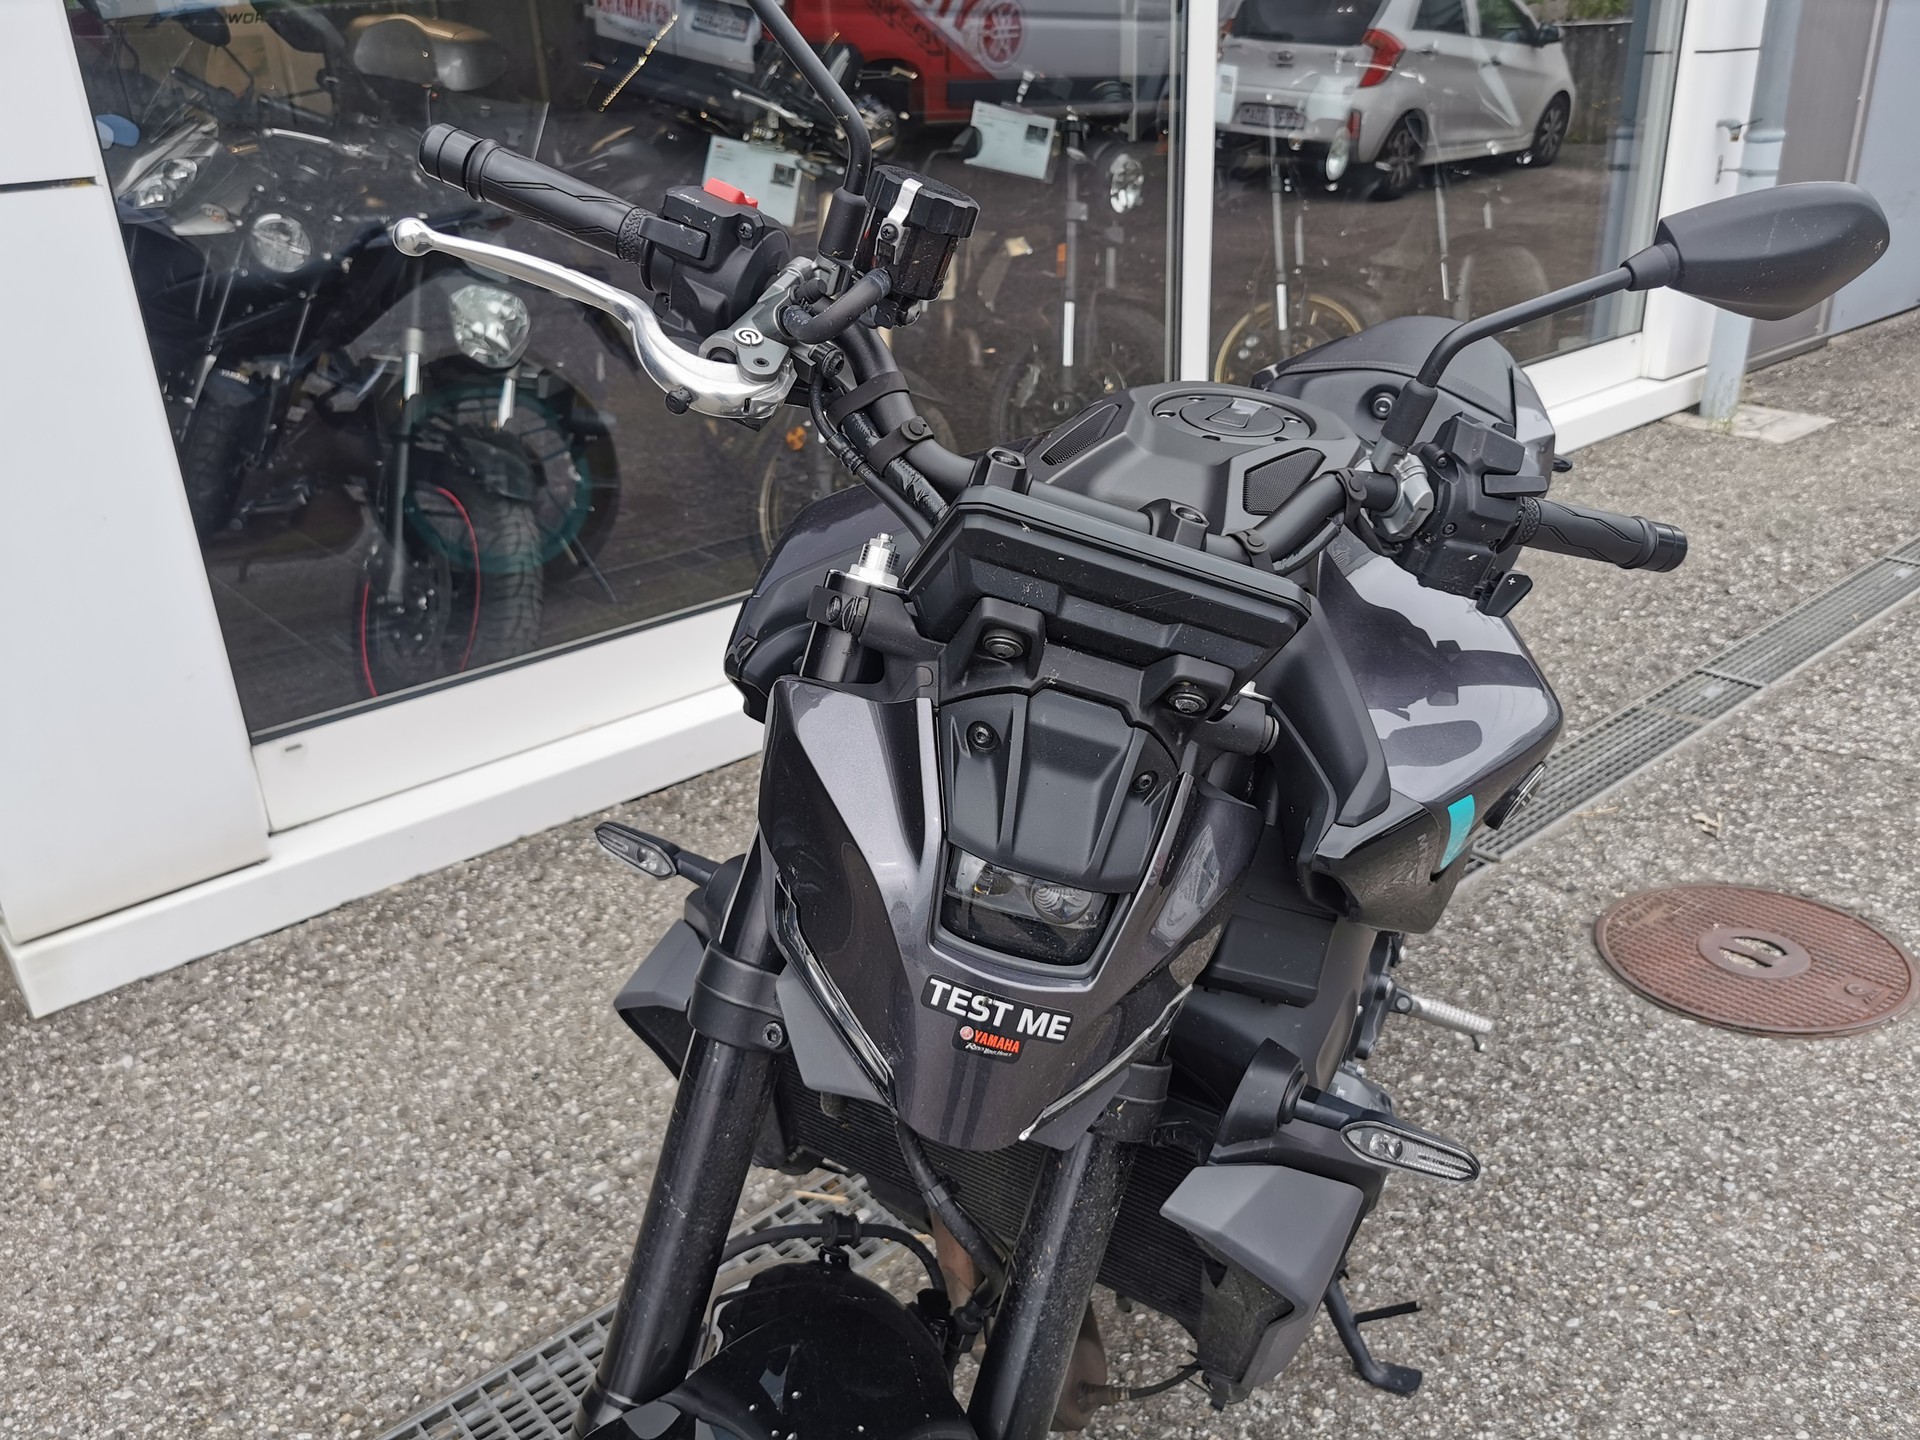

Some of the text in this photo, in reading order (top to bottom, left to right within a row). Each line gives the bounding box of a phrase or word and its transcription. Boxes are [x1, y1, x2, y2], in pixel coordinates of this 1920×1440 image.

[930, 978, 1071, 1041] TEST ME
[973, 1029, 1020, 1053] YAMAHA
